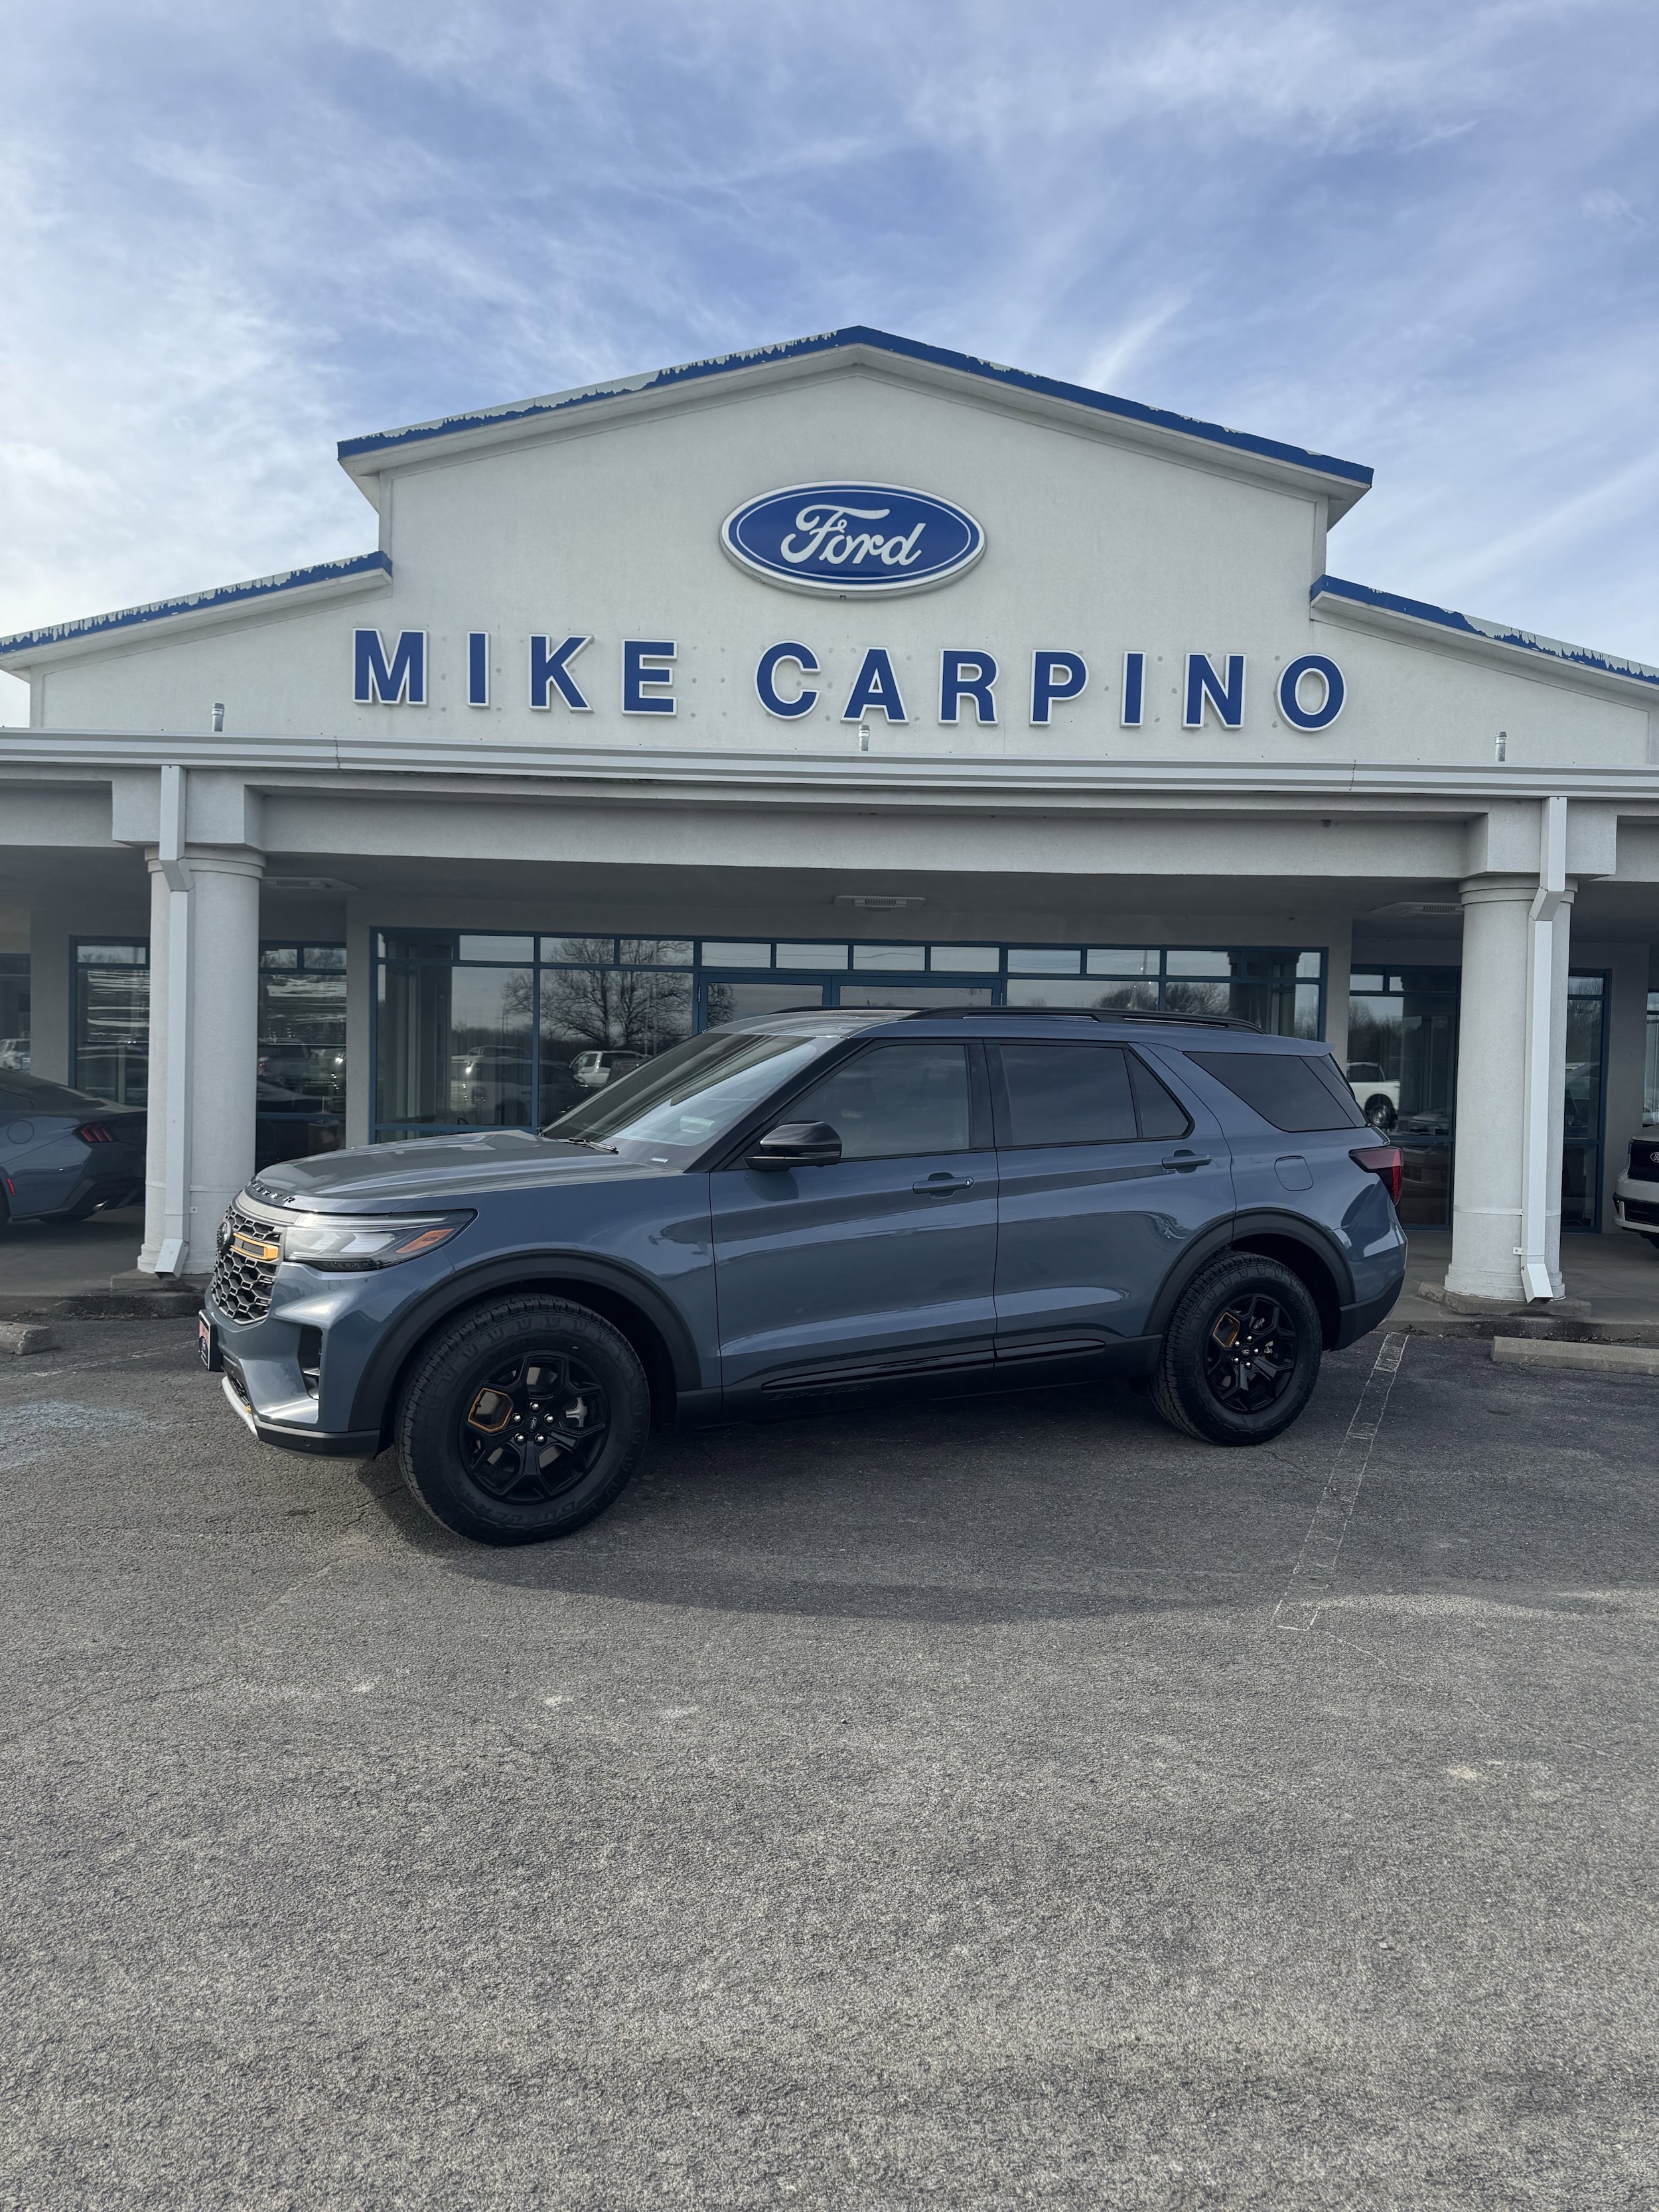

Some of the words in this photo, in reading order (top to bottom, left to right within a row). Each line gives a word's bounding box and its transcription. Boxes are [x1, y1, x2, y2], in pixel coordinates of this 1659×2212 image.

[780, 504, 926, 566] Ford
[352, 627, 678, 717] MIKE
[755, 639, 1348, 733] CARPINO
